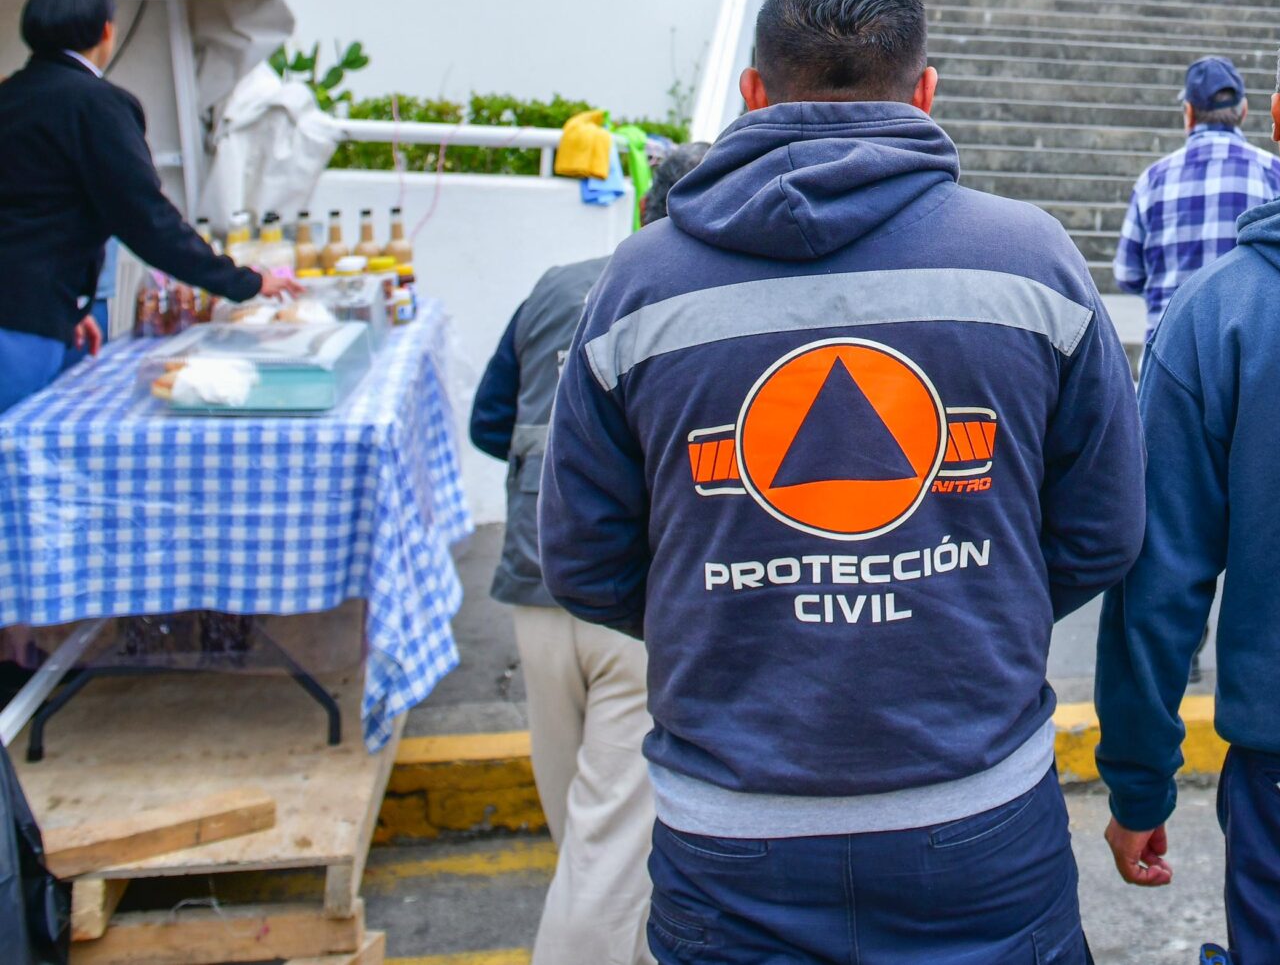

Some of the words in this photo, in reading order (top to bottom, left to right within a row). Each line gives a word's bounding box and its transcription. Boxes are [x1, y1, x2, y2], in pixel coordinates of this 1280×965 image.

[931, 477, 992, 493] NITRO
[705, 535, 990, 590] PROTECCIÓN
[794, 593, 912, 623] CIVIL
